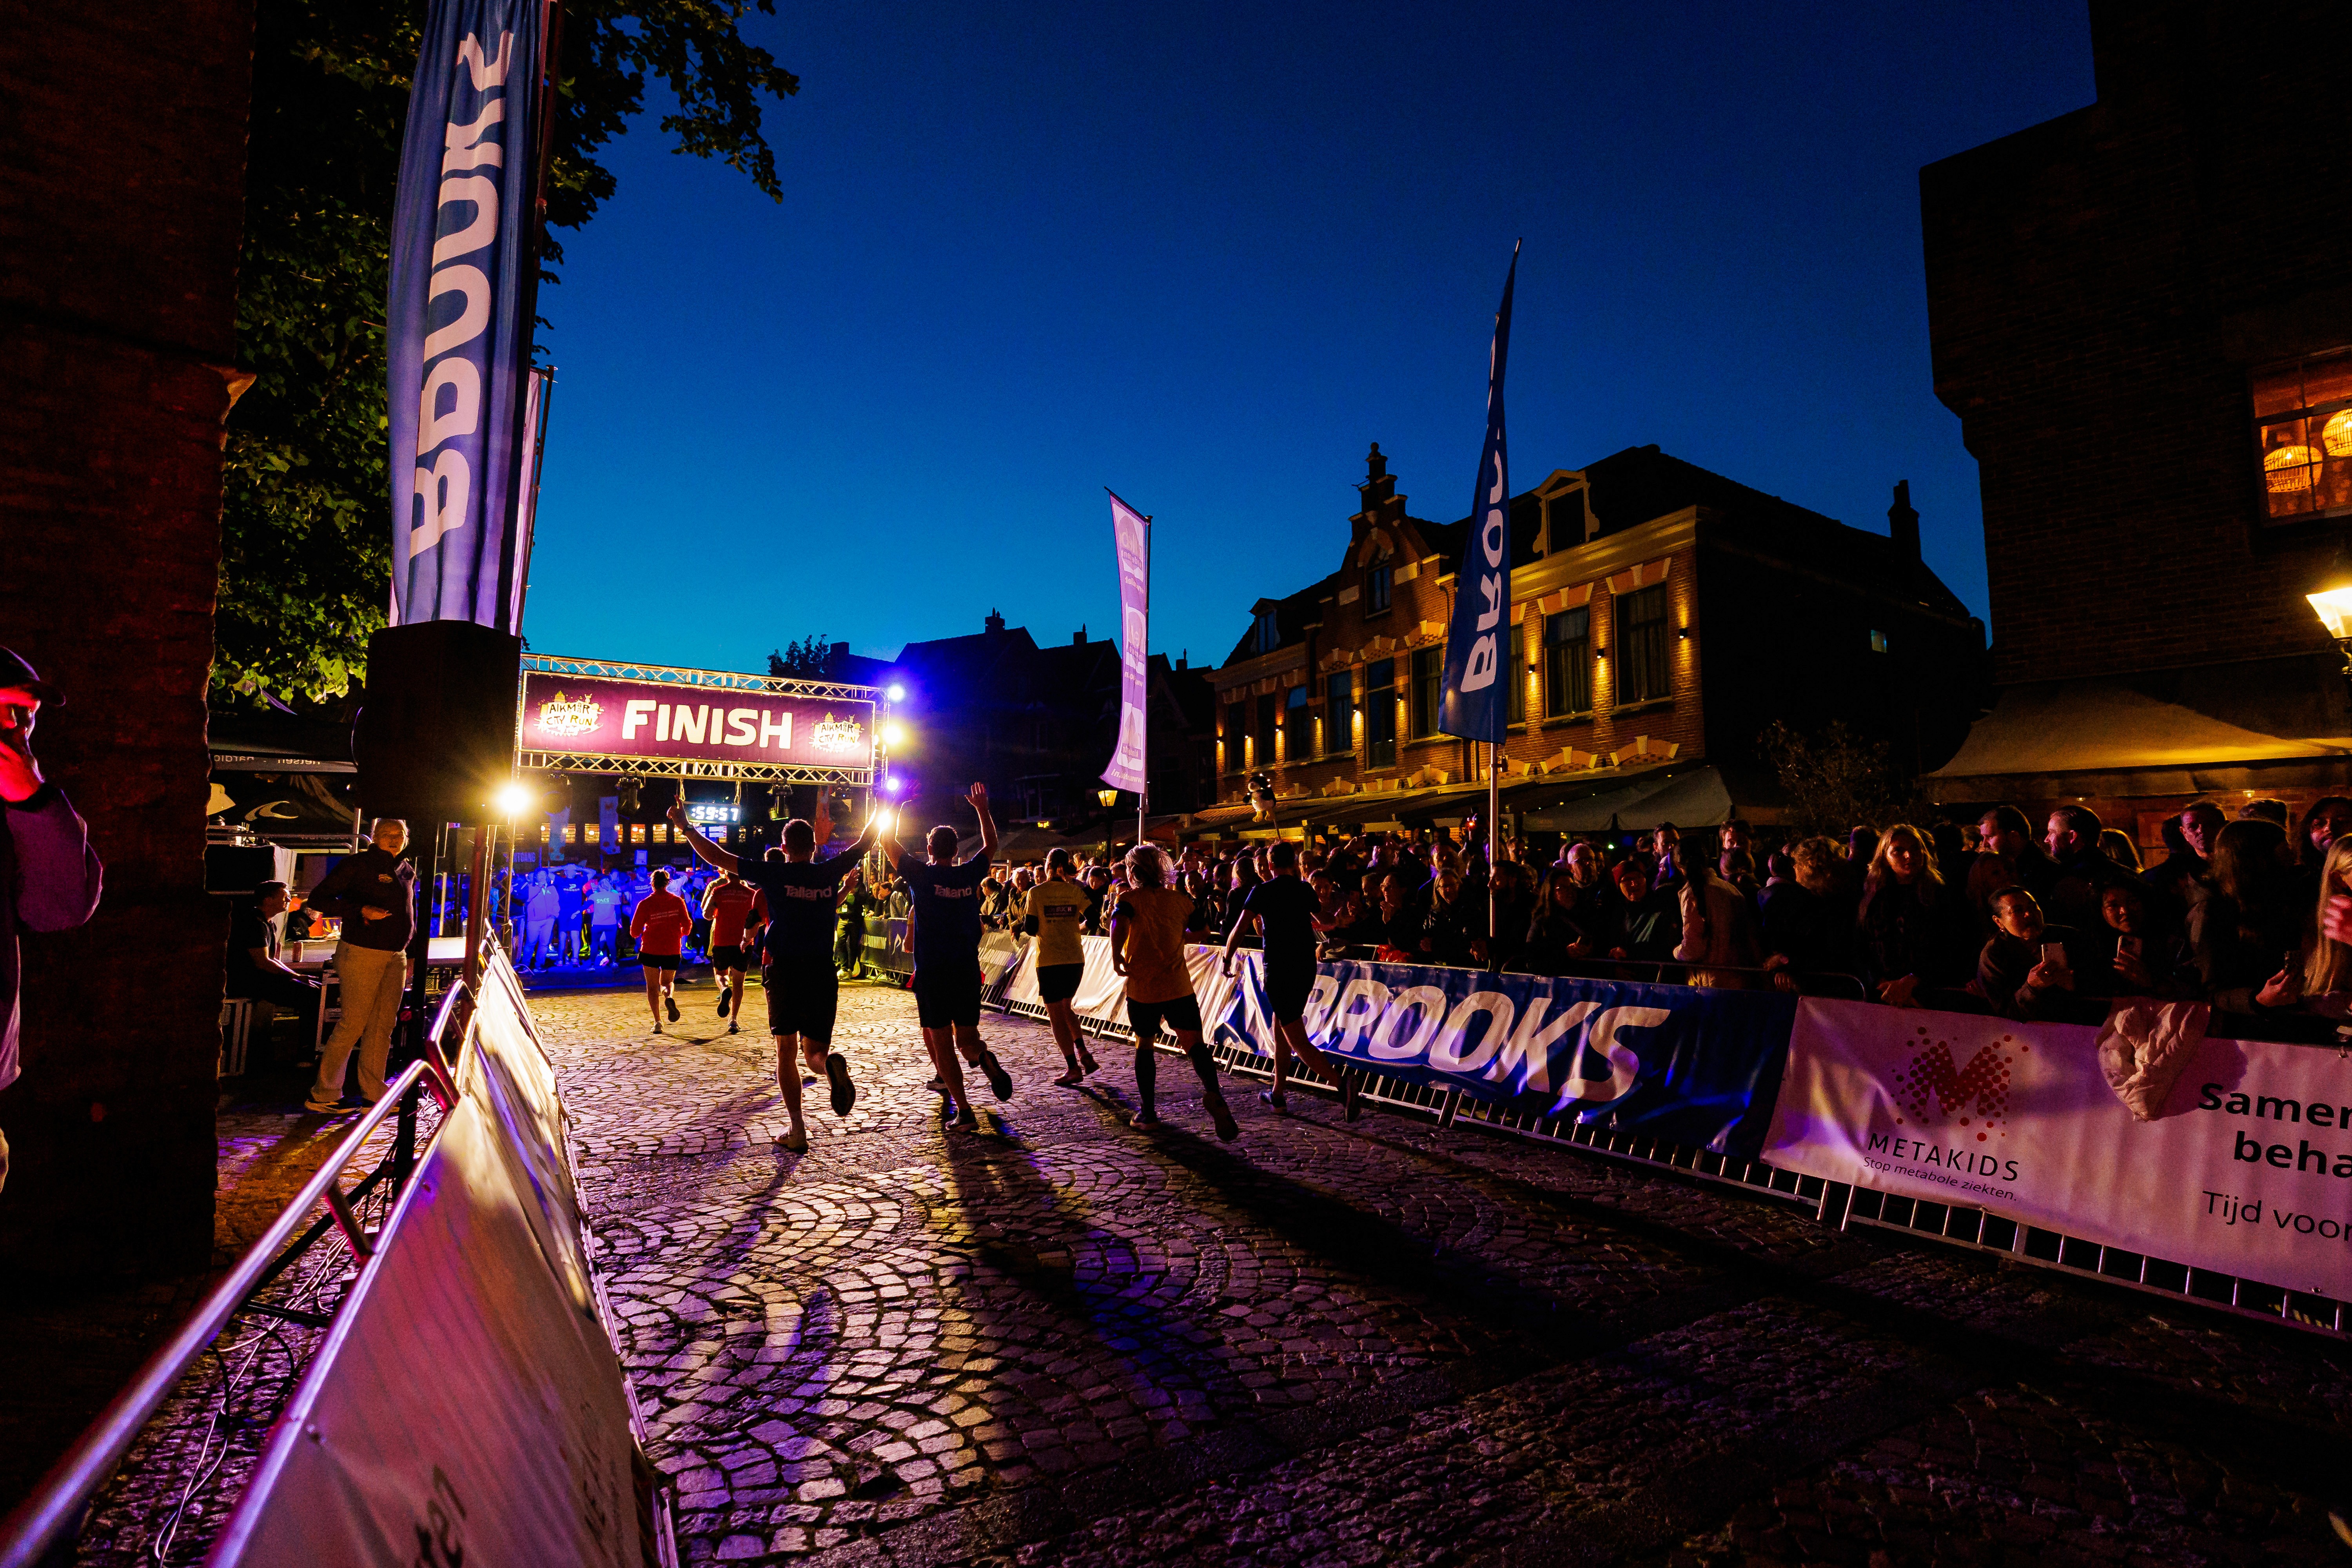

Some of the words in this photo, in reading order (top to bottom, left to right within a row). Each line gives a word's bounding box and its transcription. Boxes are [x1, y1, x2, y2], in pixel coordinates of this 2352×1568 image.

[622, 699, 793, 750] FINISH
[1302, 975, 1670, 1102] BROOKS
[1867, 1132, 2019, 1181] METAKIDS
[2234, 1131, 2352, 1178] beha
[1863, 1157, 1891, 1173] Stop
[1894, 1165, 1958, 1186] metabole
[1961, 1180, 2017, 1201] ziekten.
[2202, 1190, 2262, 1225] Tijd
